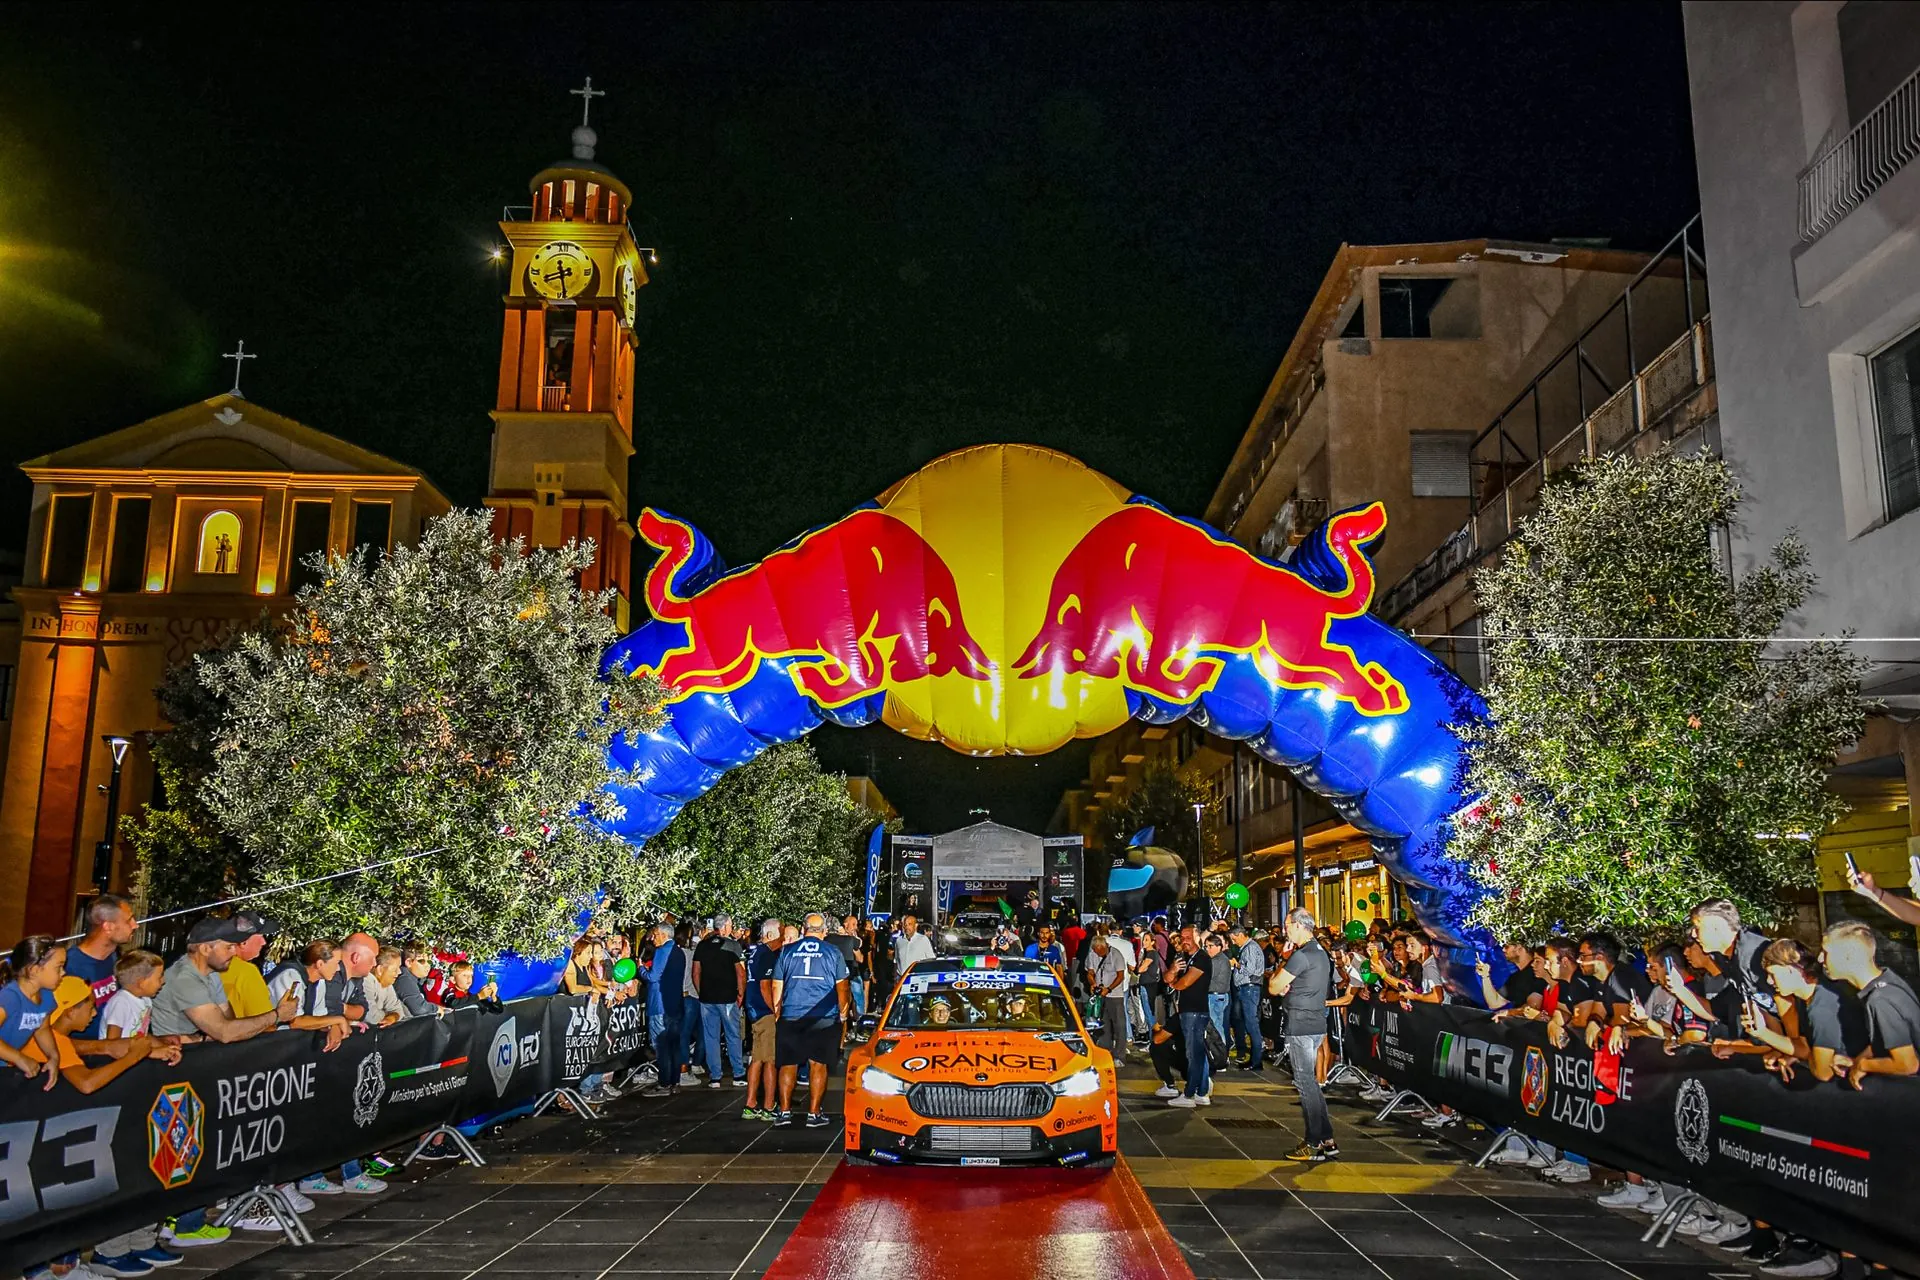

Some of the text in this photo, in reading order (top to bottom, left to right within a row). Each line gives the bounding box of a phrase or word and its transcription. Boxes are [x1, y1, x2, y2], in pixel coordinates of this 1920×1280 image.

[31, 616, 52, 631] IN
[61, 619, 149, 636] HONOREM
[944, 972, 1020, 982] sparco
[909, 983, 919, 993] 5
[565, 1035, 599, 1048] EUROPEAN
[496, 1043, 512, 1067] ACI
[565, 1047, 598, 1064] RALLY
[565, 1064, 589, 1076] TROP
[931, 1067, 980, 1075] ELECTRIC
[1446, 1034, 1514, 1098] M33
[1555, 1053, 1634, 1101] REGIE
[216, 1062, 317, 1120] REGIONE
[429, 1080, 445, 1096] Sport
[1551, 1090, 1605, 1134] LAZIO
[215, 1114, 286, 1171] LAZIO
[1718, 1137, 1869, 1198] Ministro per lo Sport e i Giovani
